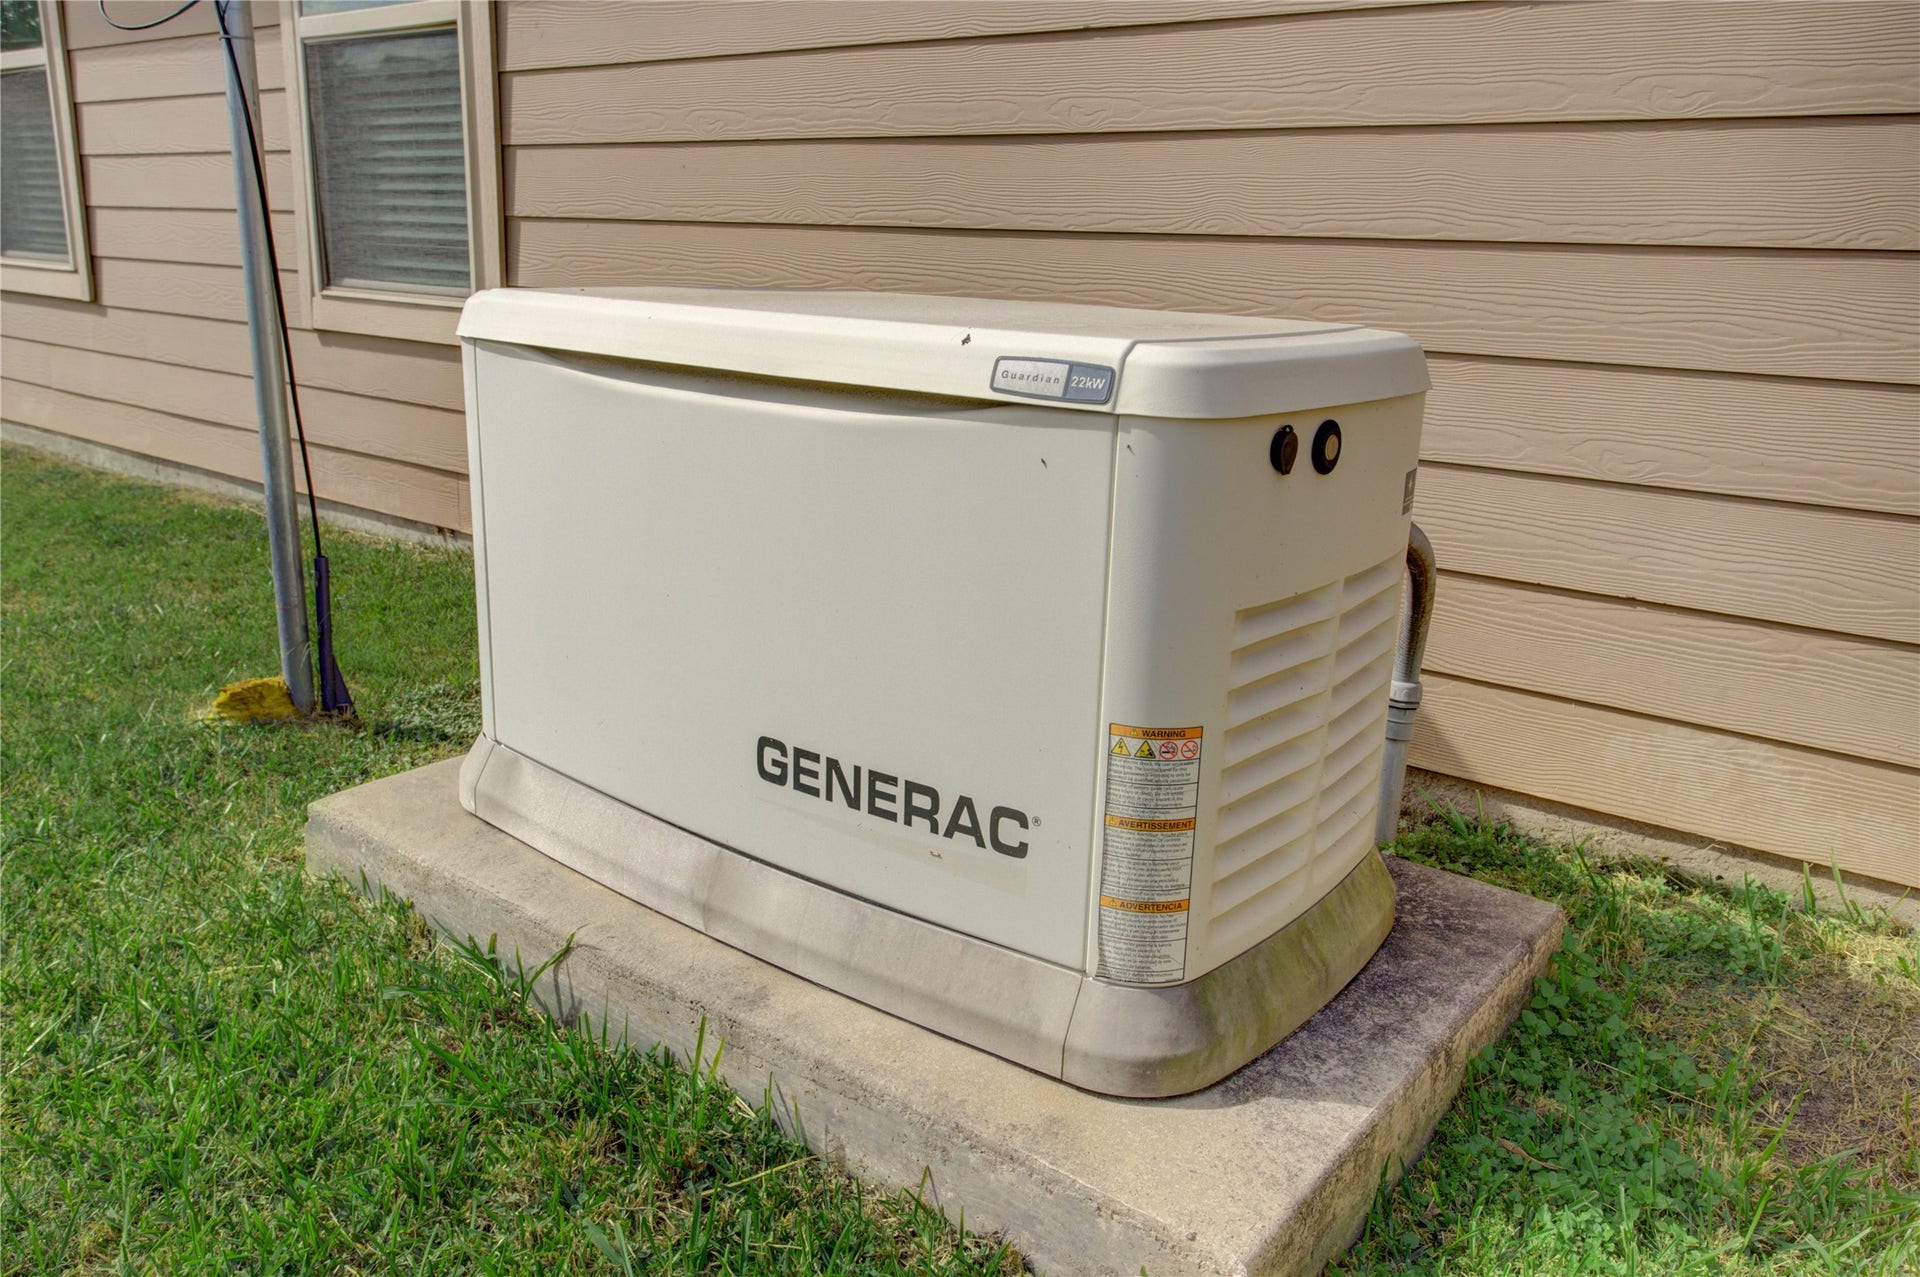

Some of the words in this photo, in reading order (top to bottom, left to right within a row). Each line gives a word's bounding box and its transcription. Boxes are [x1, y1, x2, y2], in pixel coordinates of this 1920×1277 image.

[1001, 369, 1060, 384] Guardian
[1071, 375, 1106, 390] 22kW
[1142, 729, 1186, 738] WARNING
[1118, 819, 1193, 830] AVERTISSEMENT
[1119, 902, 1183, 912] ADVERTENCIA
